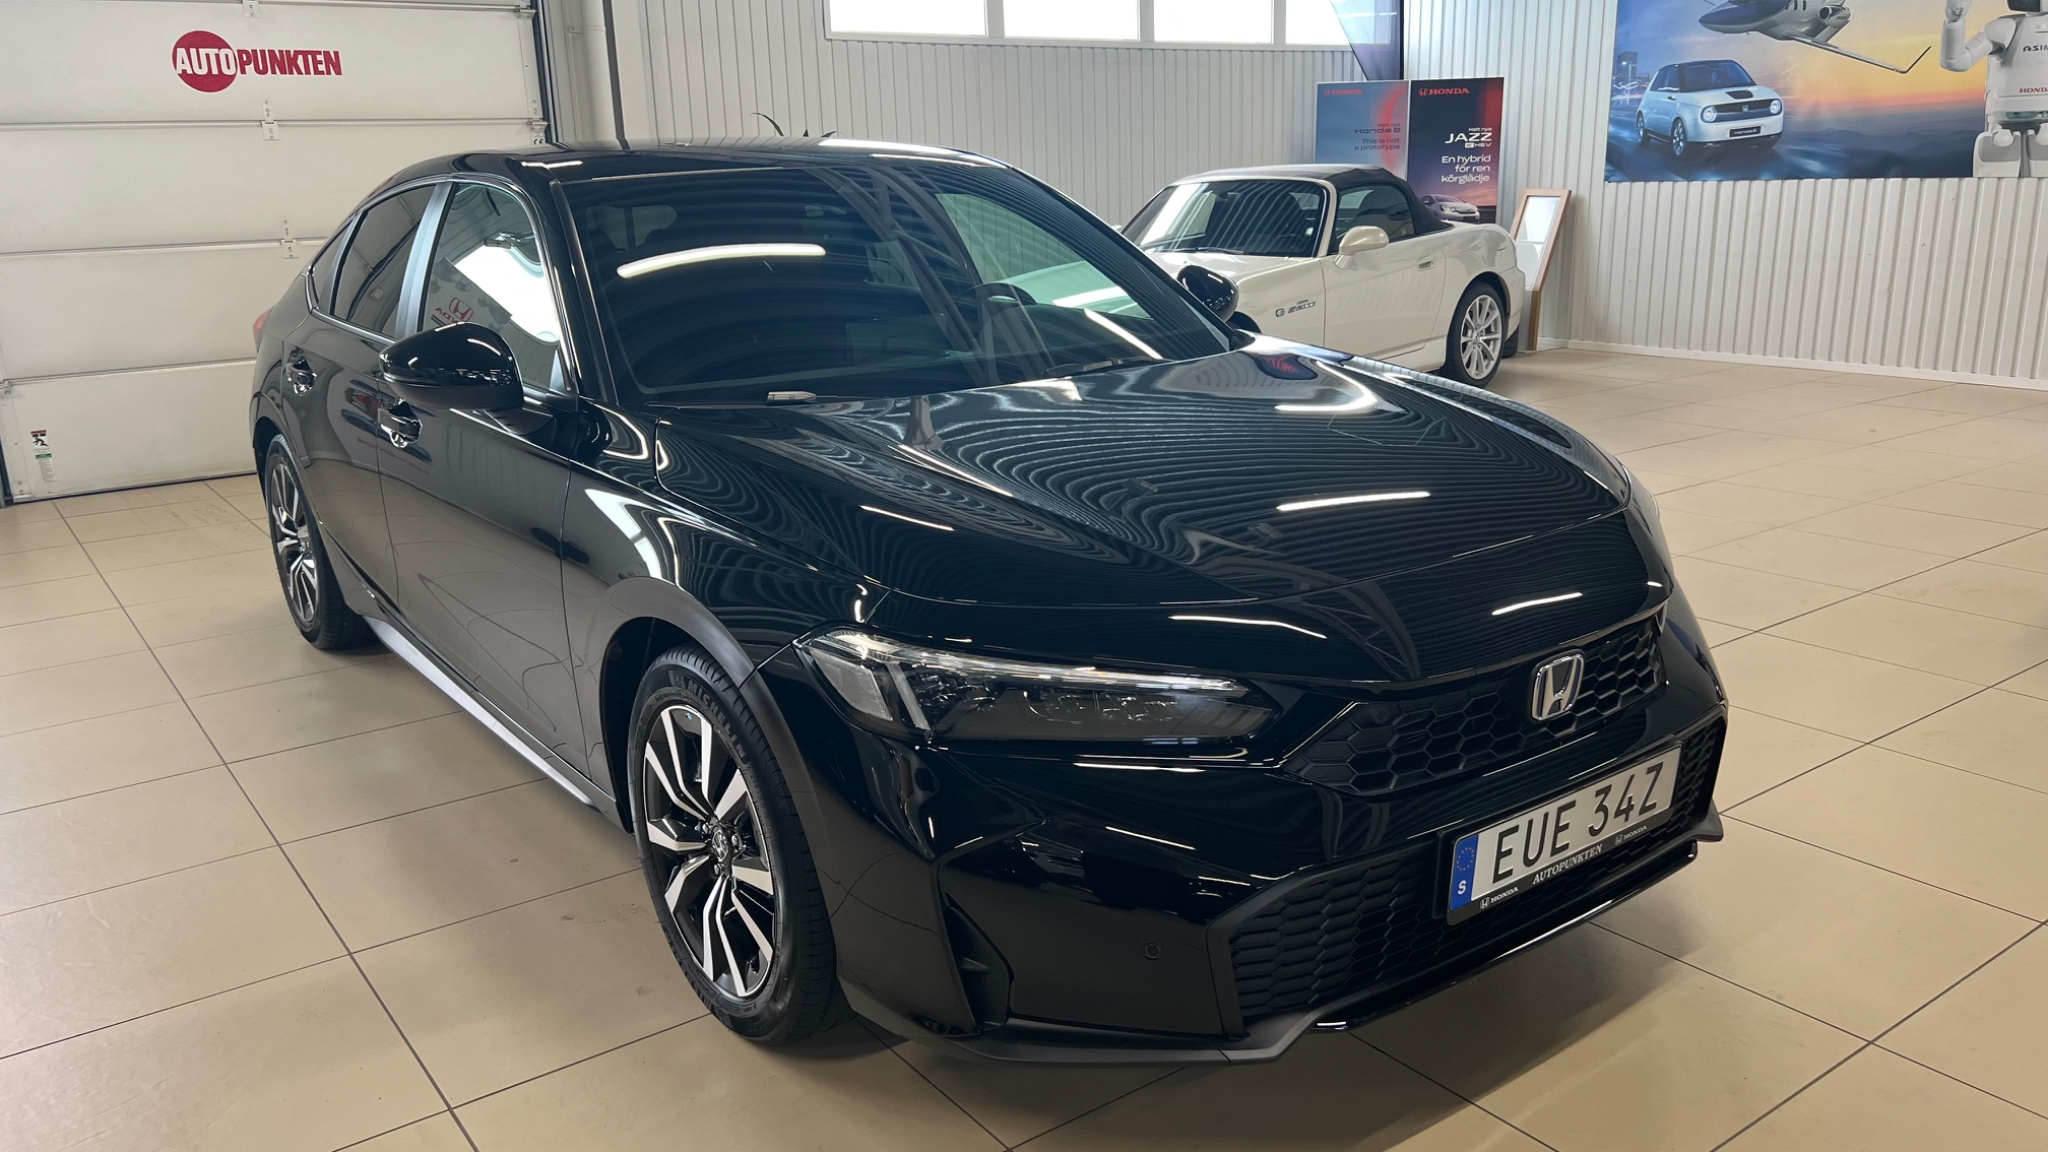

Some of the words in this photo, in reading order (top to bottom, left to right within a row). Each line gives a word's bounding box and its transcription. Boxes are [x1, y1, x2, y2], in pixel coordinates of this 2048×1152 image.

[1444, 132, 1492, 144] JAZZ
[1457, 154, 1491, 165] hybrid
[1455, 164, 1470, 172] för
[1441, 174, 1490, 184] körglädje
[688, 681, 746, 758] MICHELIN
[1492, 800, 1577, 884] EUE
[1588, 761, 1664, 837] 34Z
[1490, 887, 1519, 903] HONDA
[1532, 843, 1603, 885] AUTOPUNKTEN
[1623, 824, 1648, 841] HONDA
[1457, 880, 1467, 896] S
